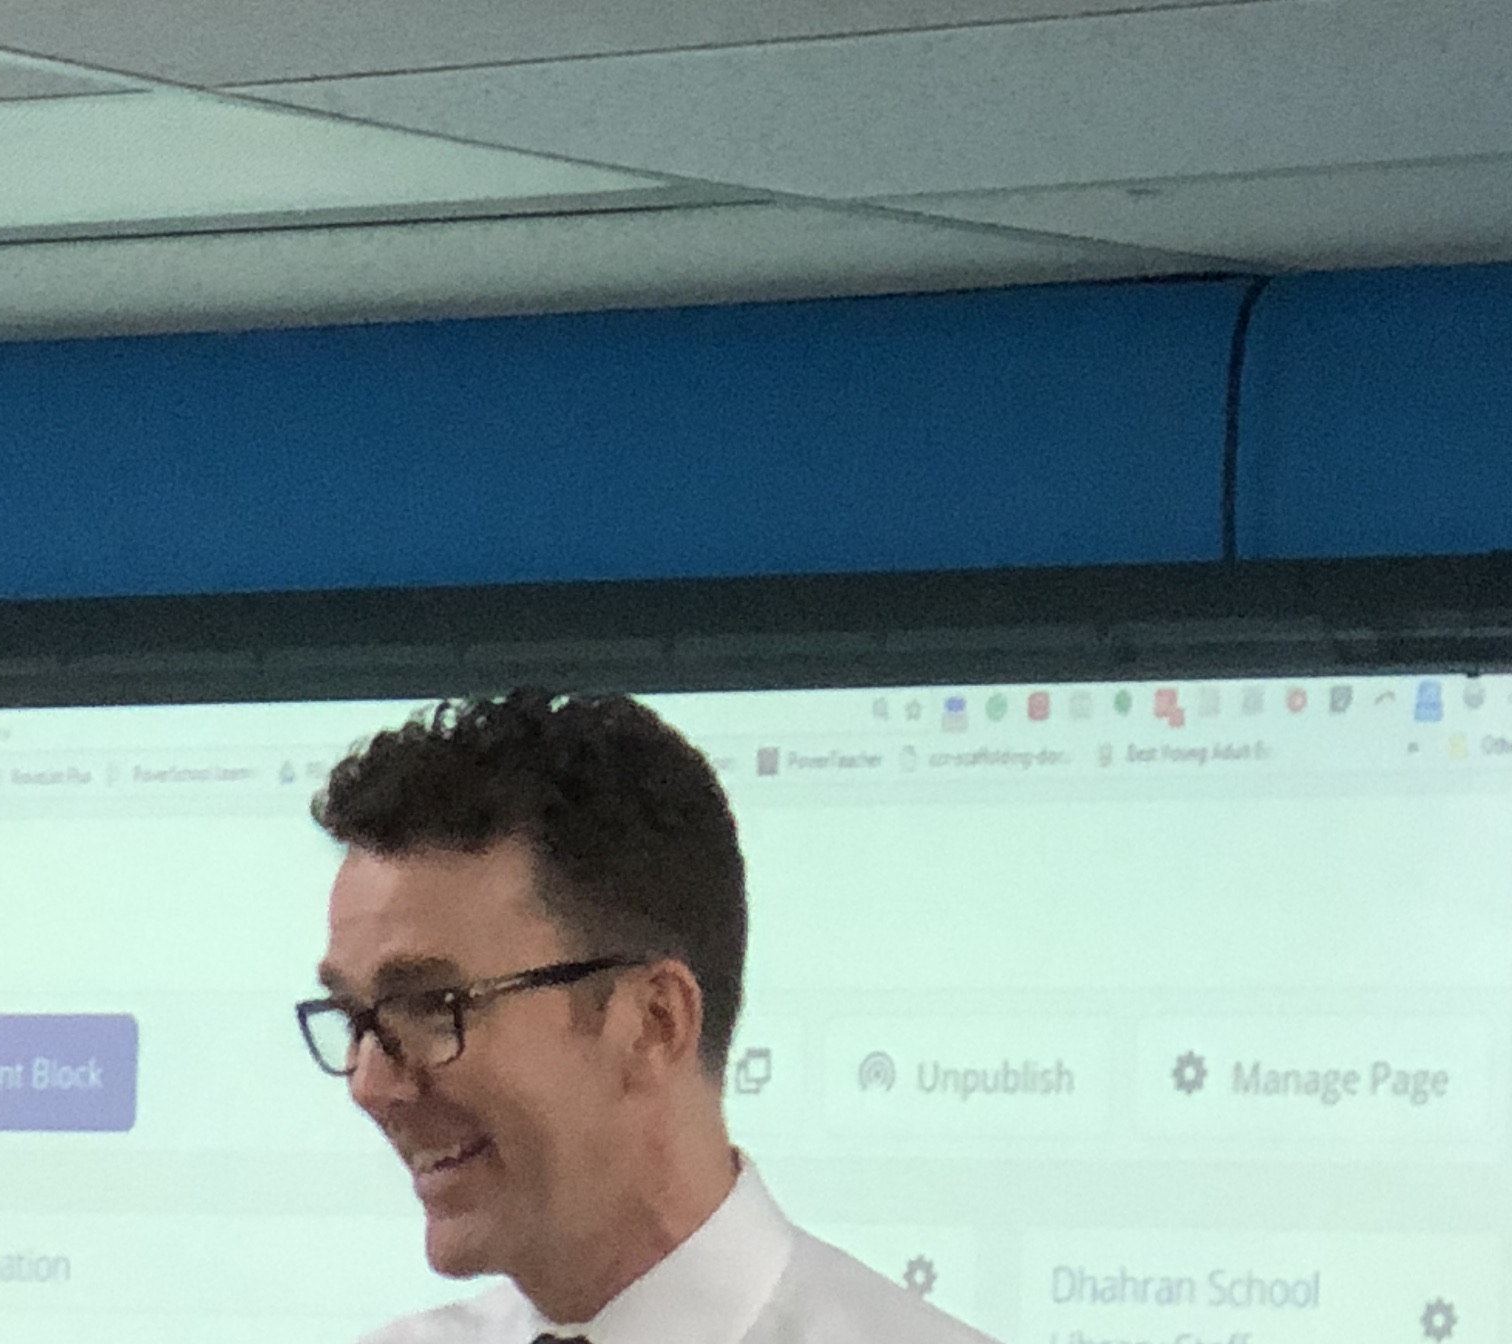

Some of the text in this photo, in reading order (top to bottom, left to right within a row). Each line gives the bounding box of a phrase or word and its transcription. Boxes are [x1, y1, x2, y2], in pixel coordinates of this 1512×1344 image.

[32, 1056, 105, 1091] Block
[918, 1059, 1076, 1099] Unpublish
[1232, 1060, 1451, 1105] Manage Page
[1050, 1266, 1321, 1309] Dhahran School
